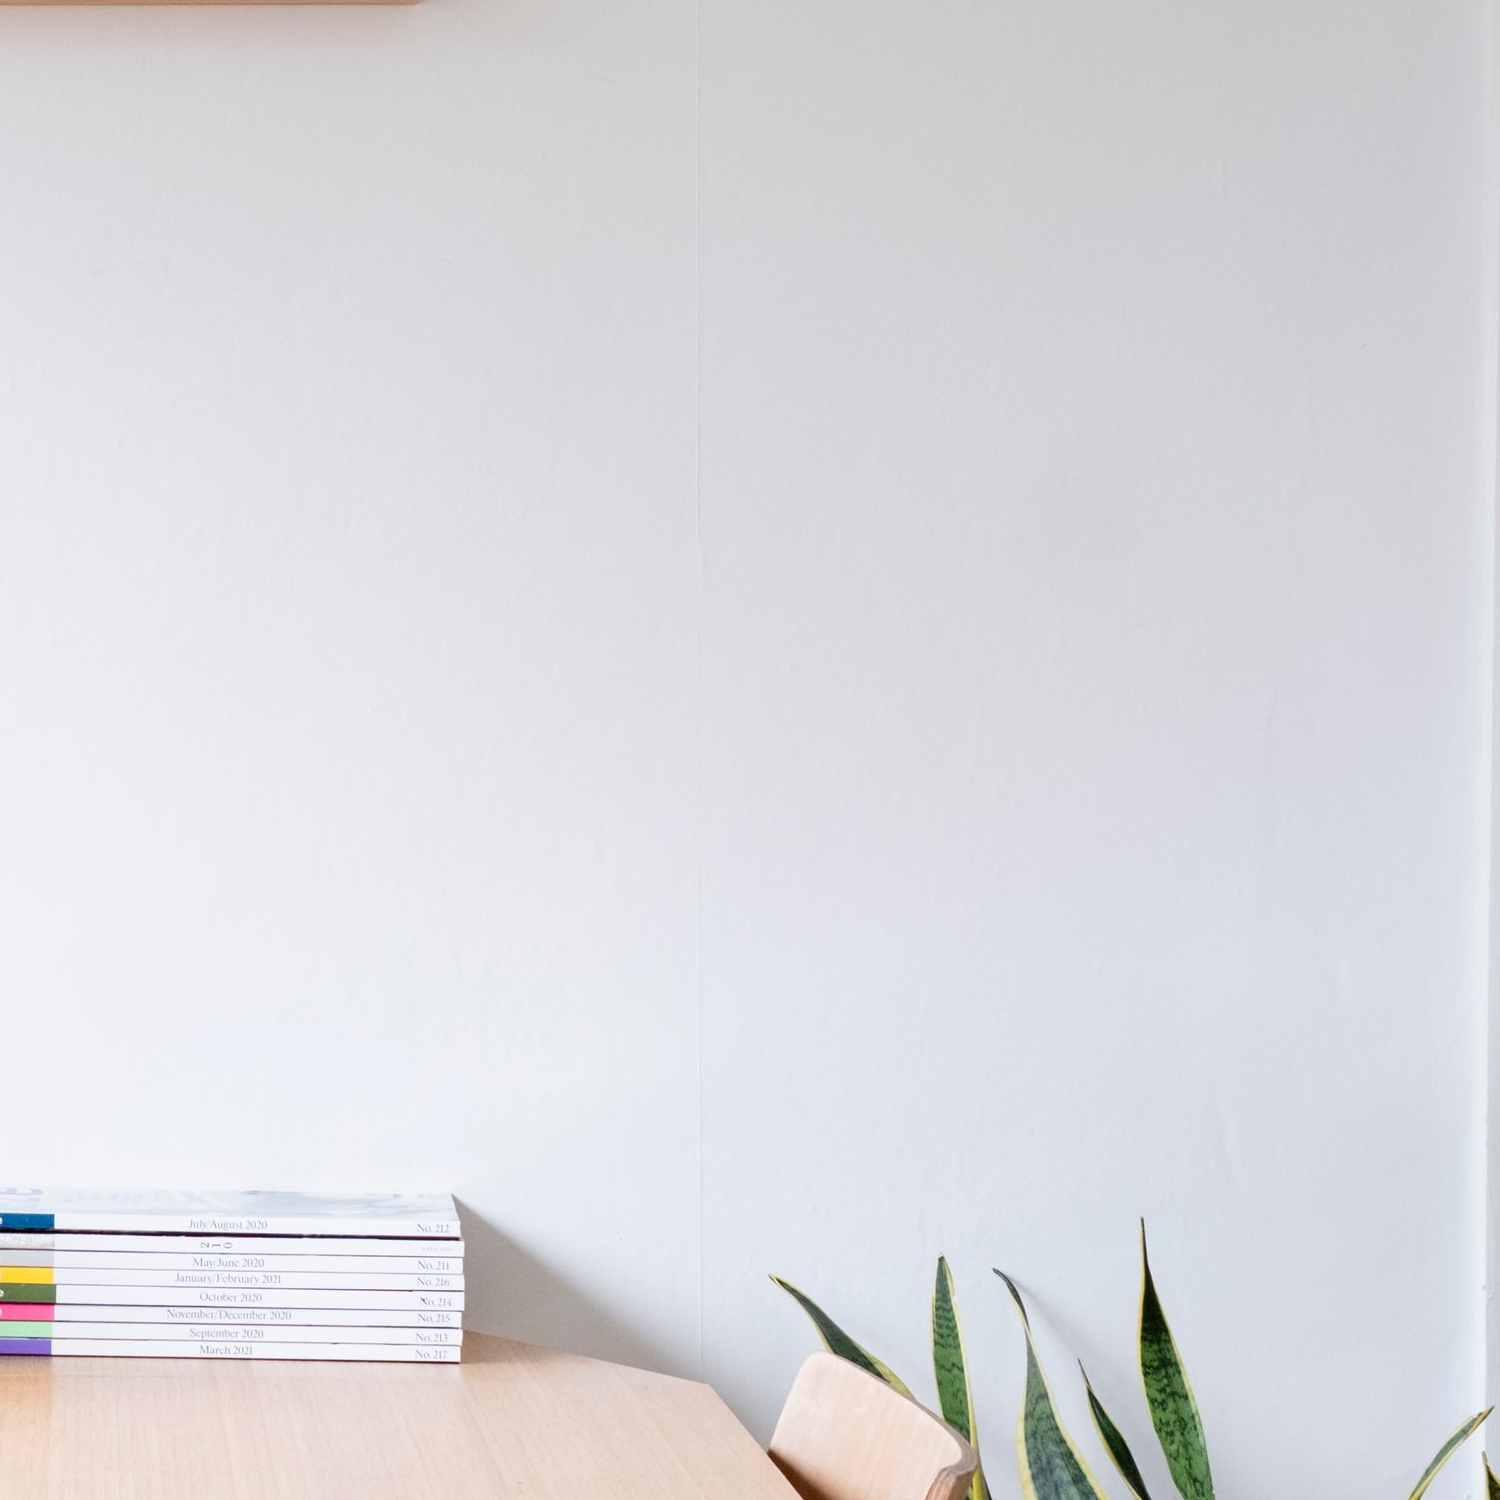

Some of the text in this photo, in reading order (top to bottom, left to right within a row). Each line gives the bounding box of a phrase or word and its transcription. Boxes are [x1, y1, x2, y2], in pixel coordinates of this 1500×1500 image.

[188, 1219, 268, 1231] July/August 2020
[435, 1224, 450, 1234] 212
[193, 1257, 265, 1268] May/June 2020
[174, 1273, 282, 1285] January/February 2021
[435, 1277, 450, 1287] 216
[199, 1292, 263, 1303] October 2020
[166, 1309, 292, 1321] November/December 2020
[436, 1313, 451, 1323] 215
[189, 1328, 265, 1339] September 2020
[433, 1333, 449, 1342] 213
[199, 1345, 254, 1355] March 2021
[433, 1350, 448, 1359] 217
